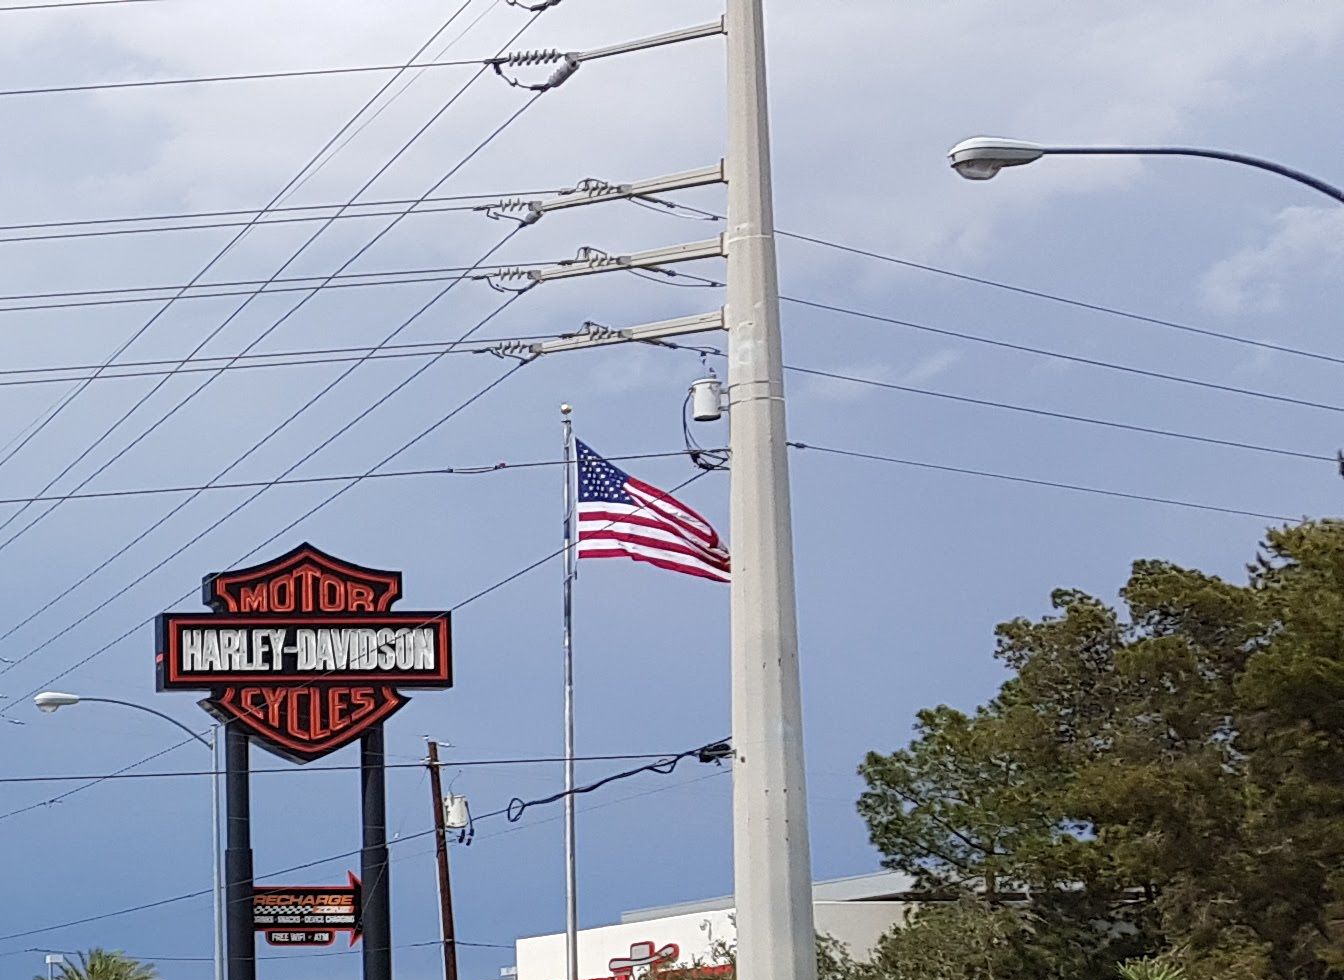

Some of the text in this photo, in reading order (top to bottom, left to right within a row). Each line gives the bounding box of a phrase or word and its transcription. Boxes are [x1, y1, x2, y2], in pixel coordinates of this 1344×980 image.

[240, 565, 375, 613] MOTOR
[182, 628, 435, 671] HARLEY-DAVIDSON
[240, 687, 376, 741] CYCLES
[253, 895, 353, 905] RECHARGE
[272, 933, 289, 941] FREE
